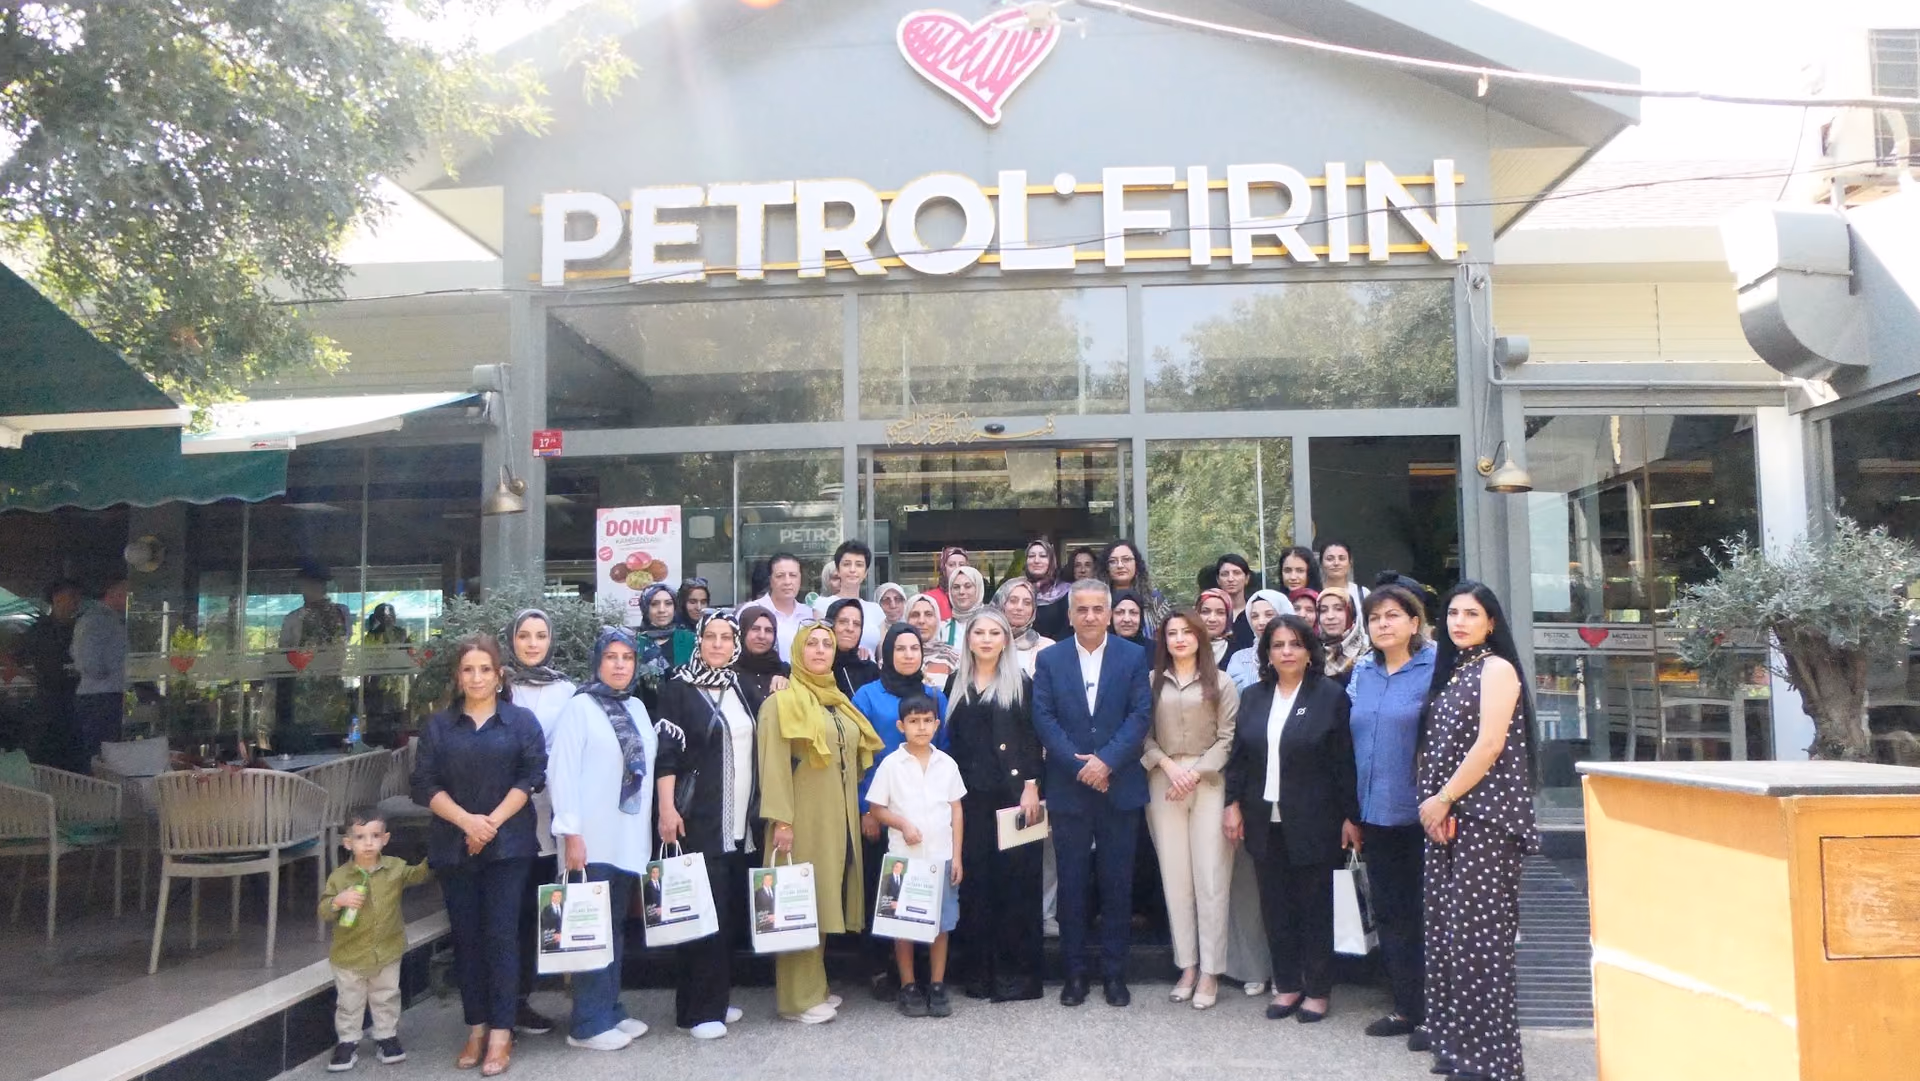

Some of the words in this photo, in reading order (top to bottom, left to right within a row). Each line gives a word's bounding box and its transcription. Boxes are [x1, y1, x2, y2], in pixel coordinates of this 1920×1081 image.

[541, 169, 1075, 287] PETROL
[1102, 162, 1457, 267] FIRIN
[605, 516, 673, 537] DONUT
